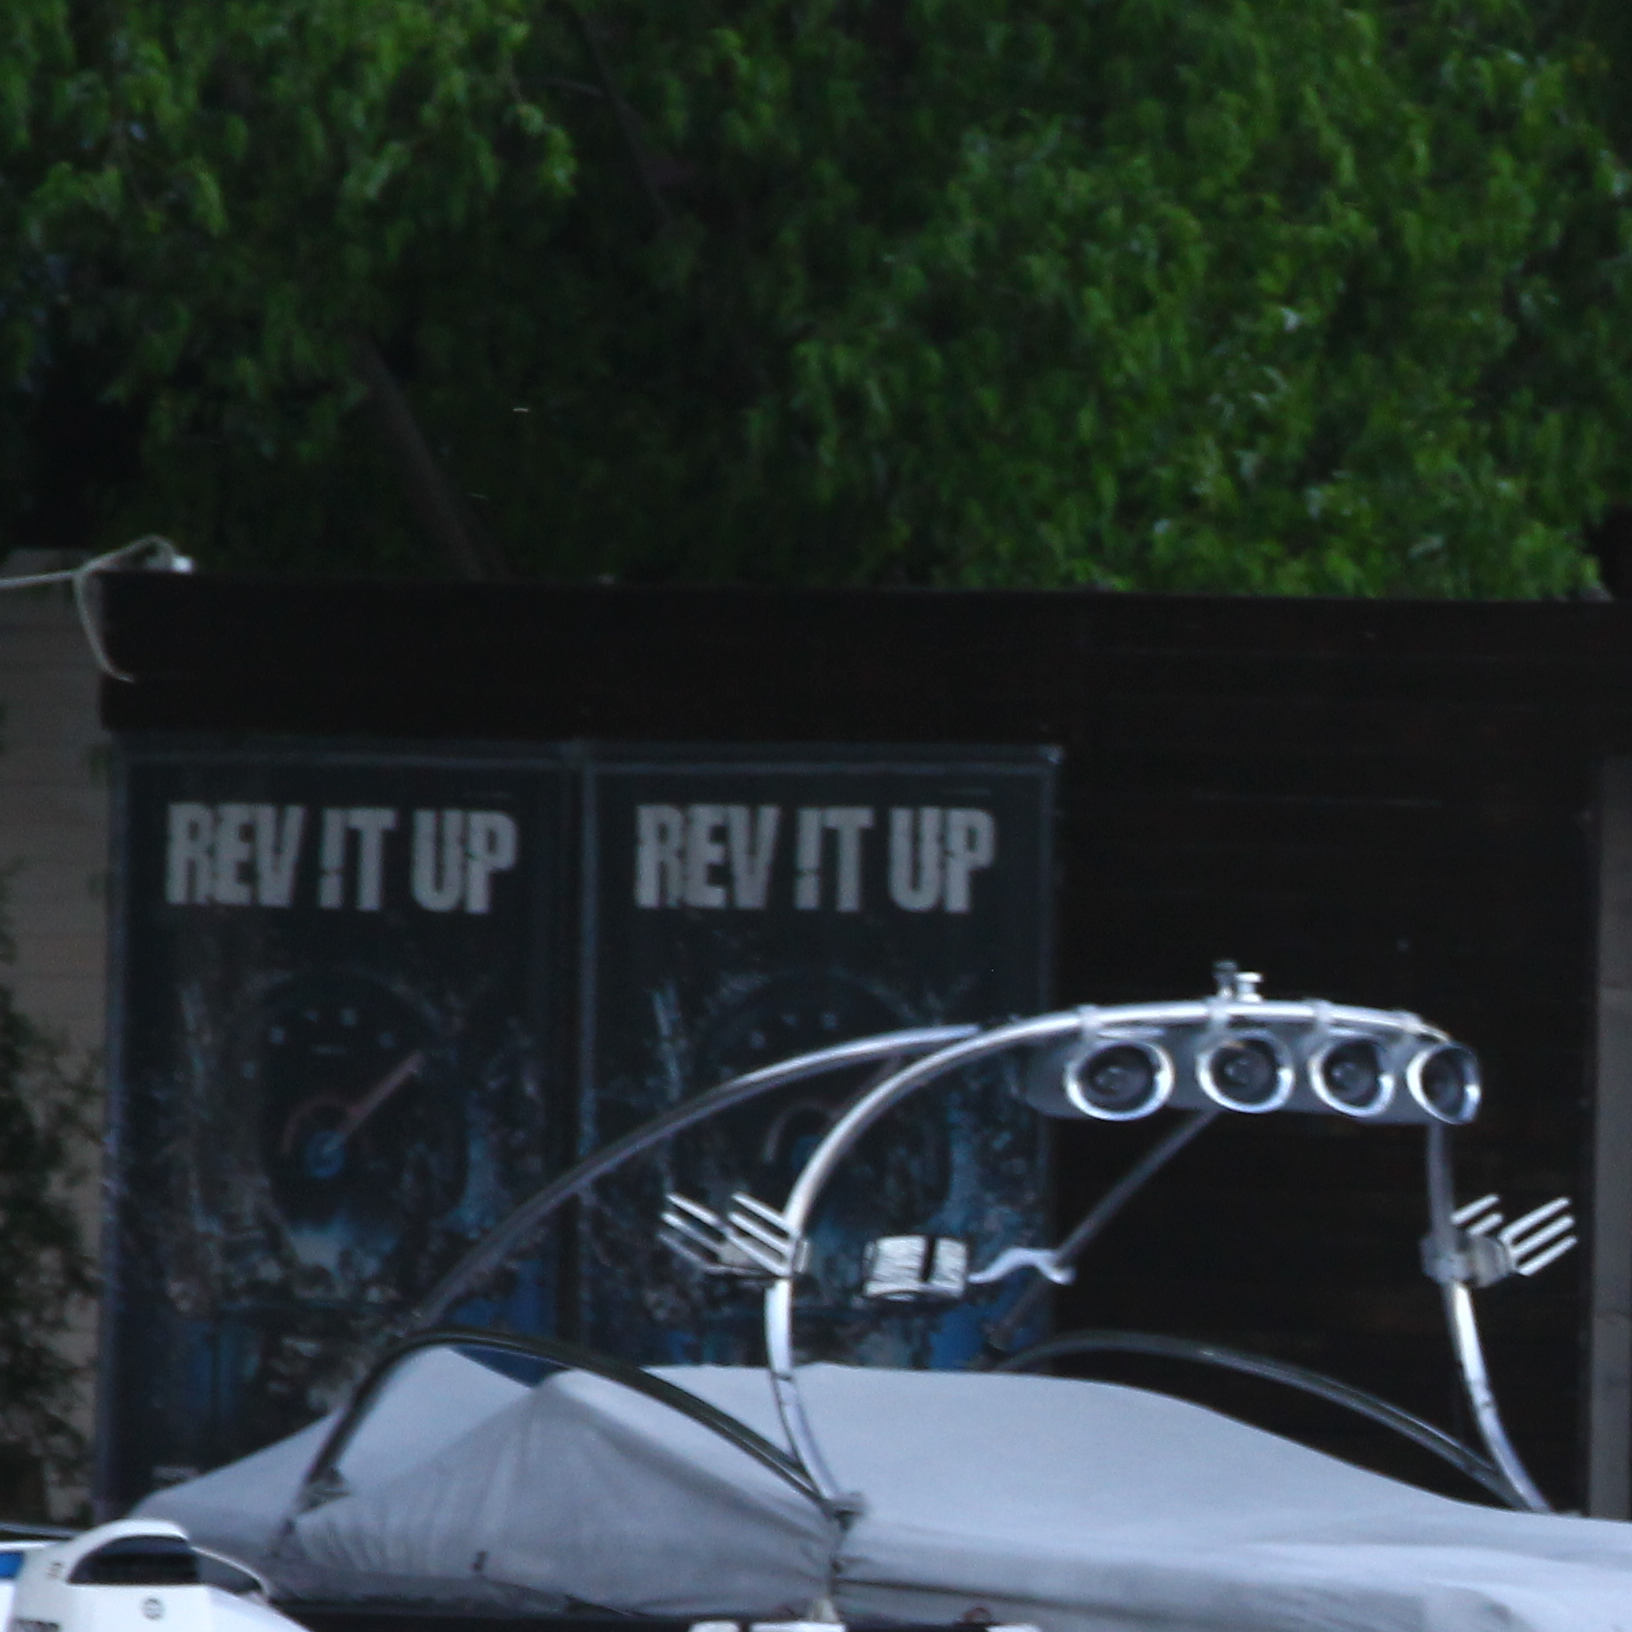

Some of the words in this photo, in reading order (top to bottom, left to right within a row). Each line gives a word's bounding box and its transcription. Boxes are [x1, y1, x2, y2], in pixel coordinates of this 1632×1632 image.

[167, 804, 302, 907] REV
[320, 808, 395, 911] IT
[413, 811, 518, 913] UP
[635, 805, 780, 909] REV
[796, 807, 875, 912] IT
[889, 808, 995, 913] UP
